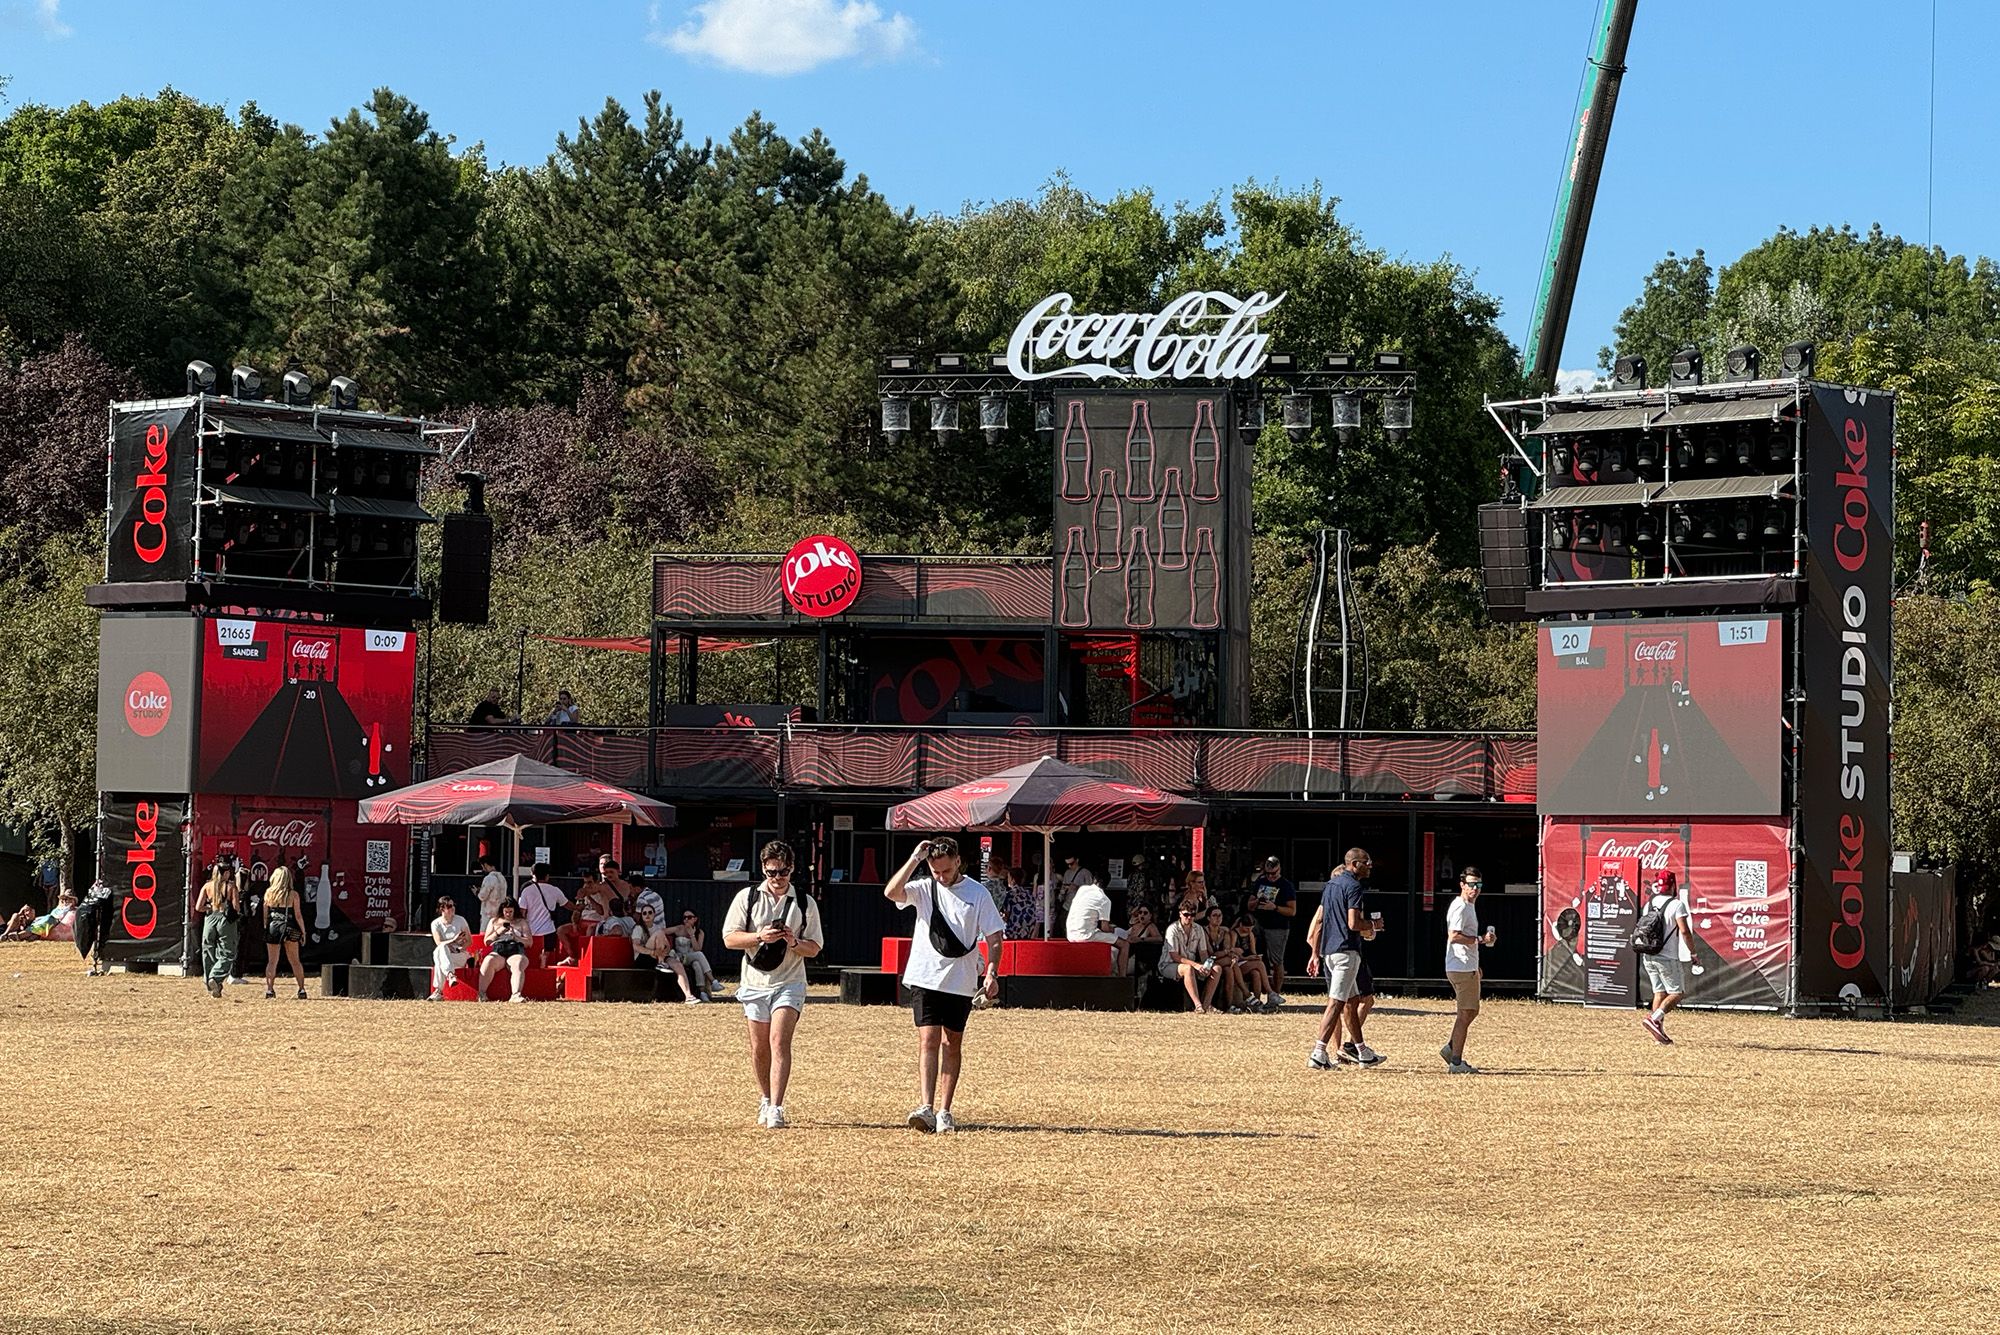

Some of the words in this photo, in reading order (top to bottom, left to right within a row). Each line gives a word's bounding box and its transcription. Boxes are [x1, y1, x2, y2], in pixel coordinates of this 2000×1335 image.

[1006, 290, 1288, 382] Coca-Cola
[133, 423, 169, 564] Coke
[1833, 417, 1868, 572] Coke
[786, 542, 856, 594] Coke
[792, 569, 857, 608] STUDIO
[220, 627, 251, 640] 21665
[1729, 626, 1754, 641] 1:51
[374, 634, 398, 648] 0:09
[1562, 633, 1579, 649] 20
[232, 647, 260, 658] SANDER
[1575, 656, 1590, 666] BAL
[129, 690, 168, 709] Coke
[303, 690, 317, 700] -20
[1841, 585, 1867, 801] STUDIO
[132, 709, 164, 719] STUDIO
[122, 801, 159, 939] Coke
[364, 876, 376, 886] Try
[377, 876, 392, 885] the
[364, 885, 391, 897] Coke
[1830, 814, 1866, 969] Coke
[367, 897, 389, 908] Run
[1732, 902, 1750, 913] Try
[1751, 902, 1769, 912] the
[365, 909, 392, 919] game!
[1732, 913, 1770, 925] Coke
[1735, 926, 1765, 939] Run
[1733, 940, 1768, 951] game!
